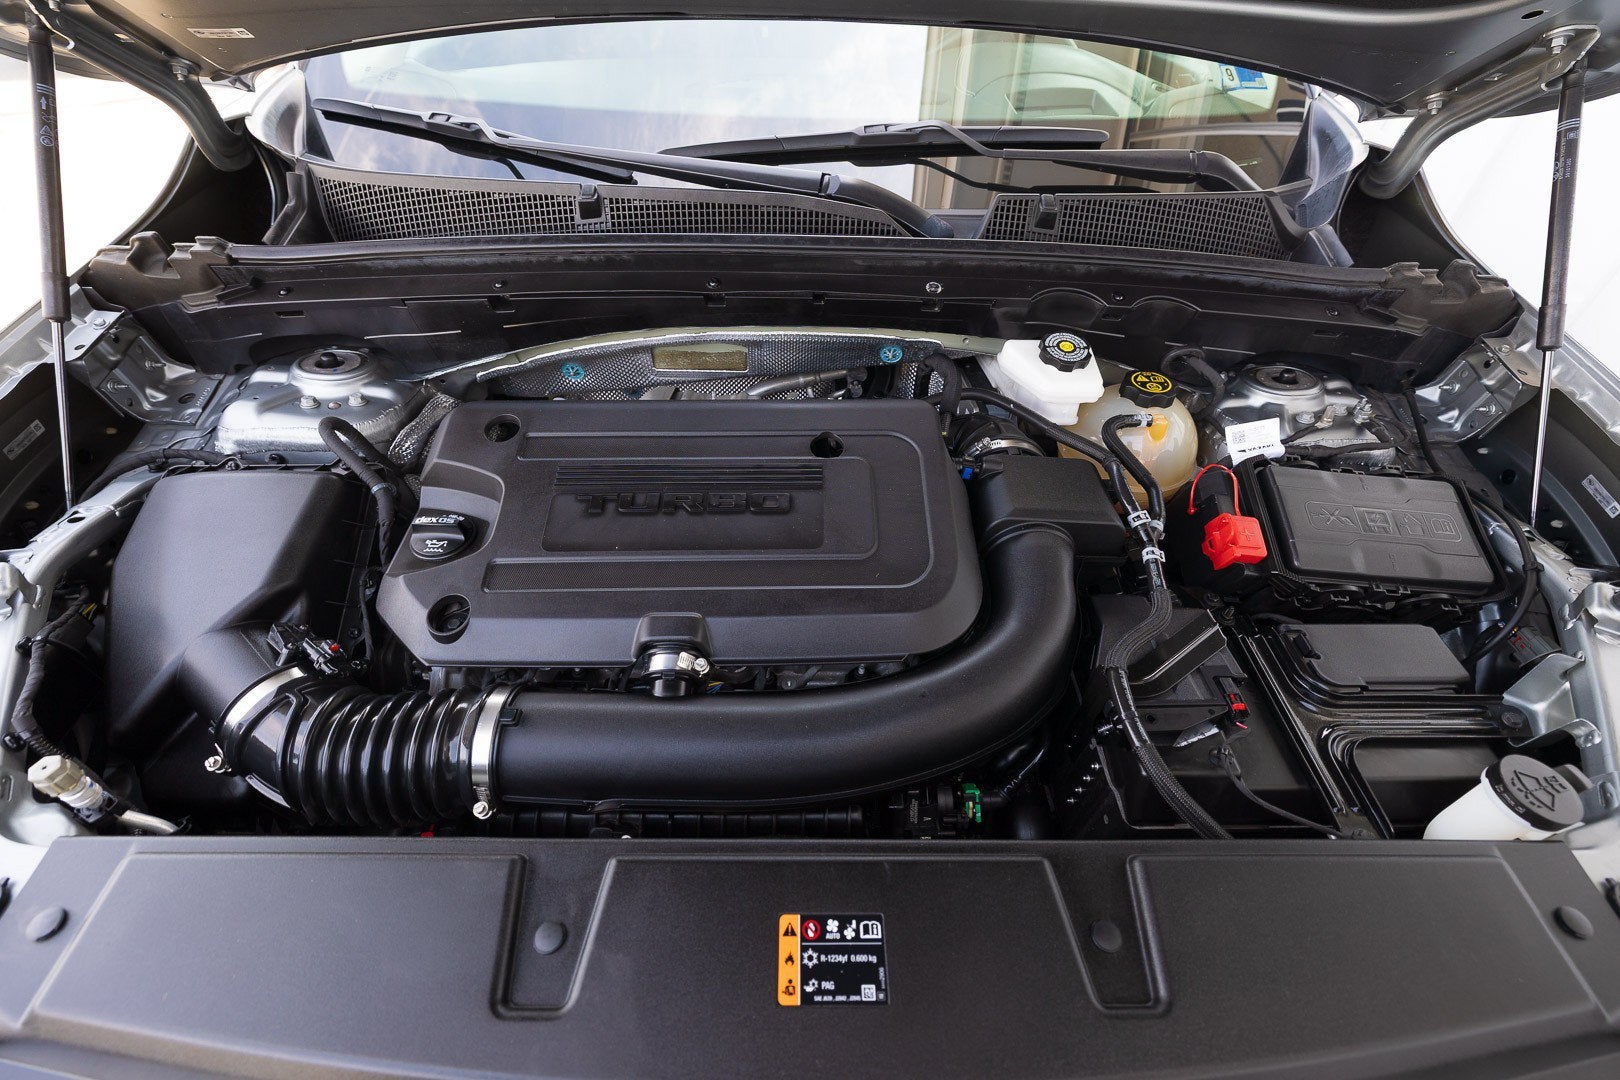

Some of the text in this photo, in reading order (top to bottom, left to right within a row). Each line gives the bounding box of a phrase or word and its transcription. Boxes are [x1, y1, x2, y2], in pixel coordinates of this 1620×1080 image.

[576, 491, 793, 514] TURBO
[415, 516, 455, 524] dexos
[825, 932, 841, 940] AUTO
[869, 955, 877, 964] kg
[821, 981, 835, 990] PAG
